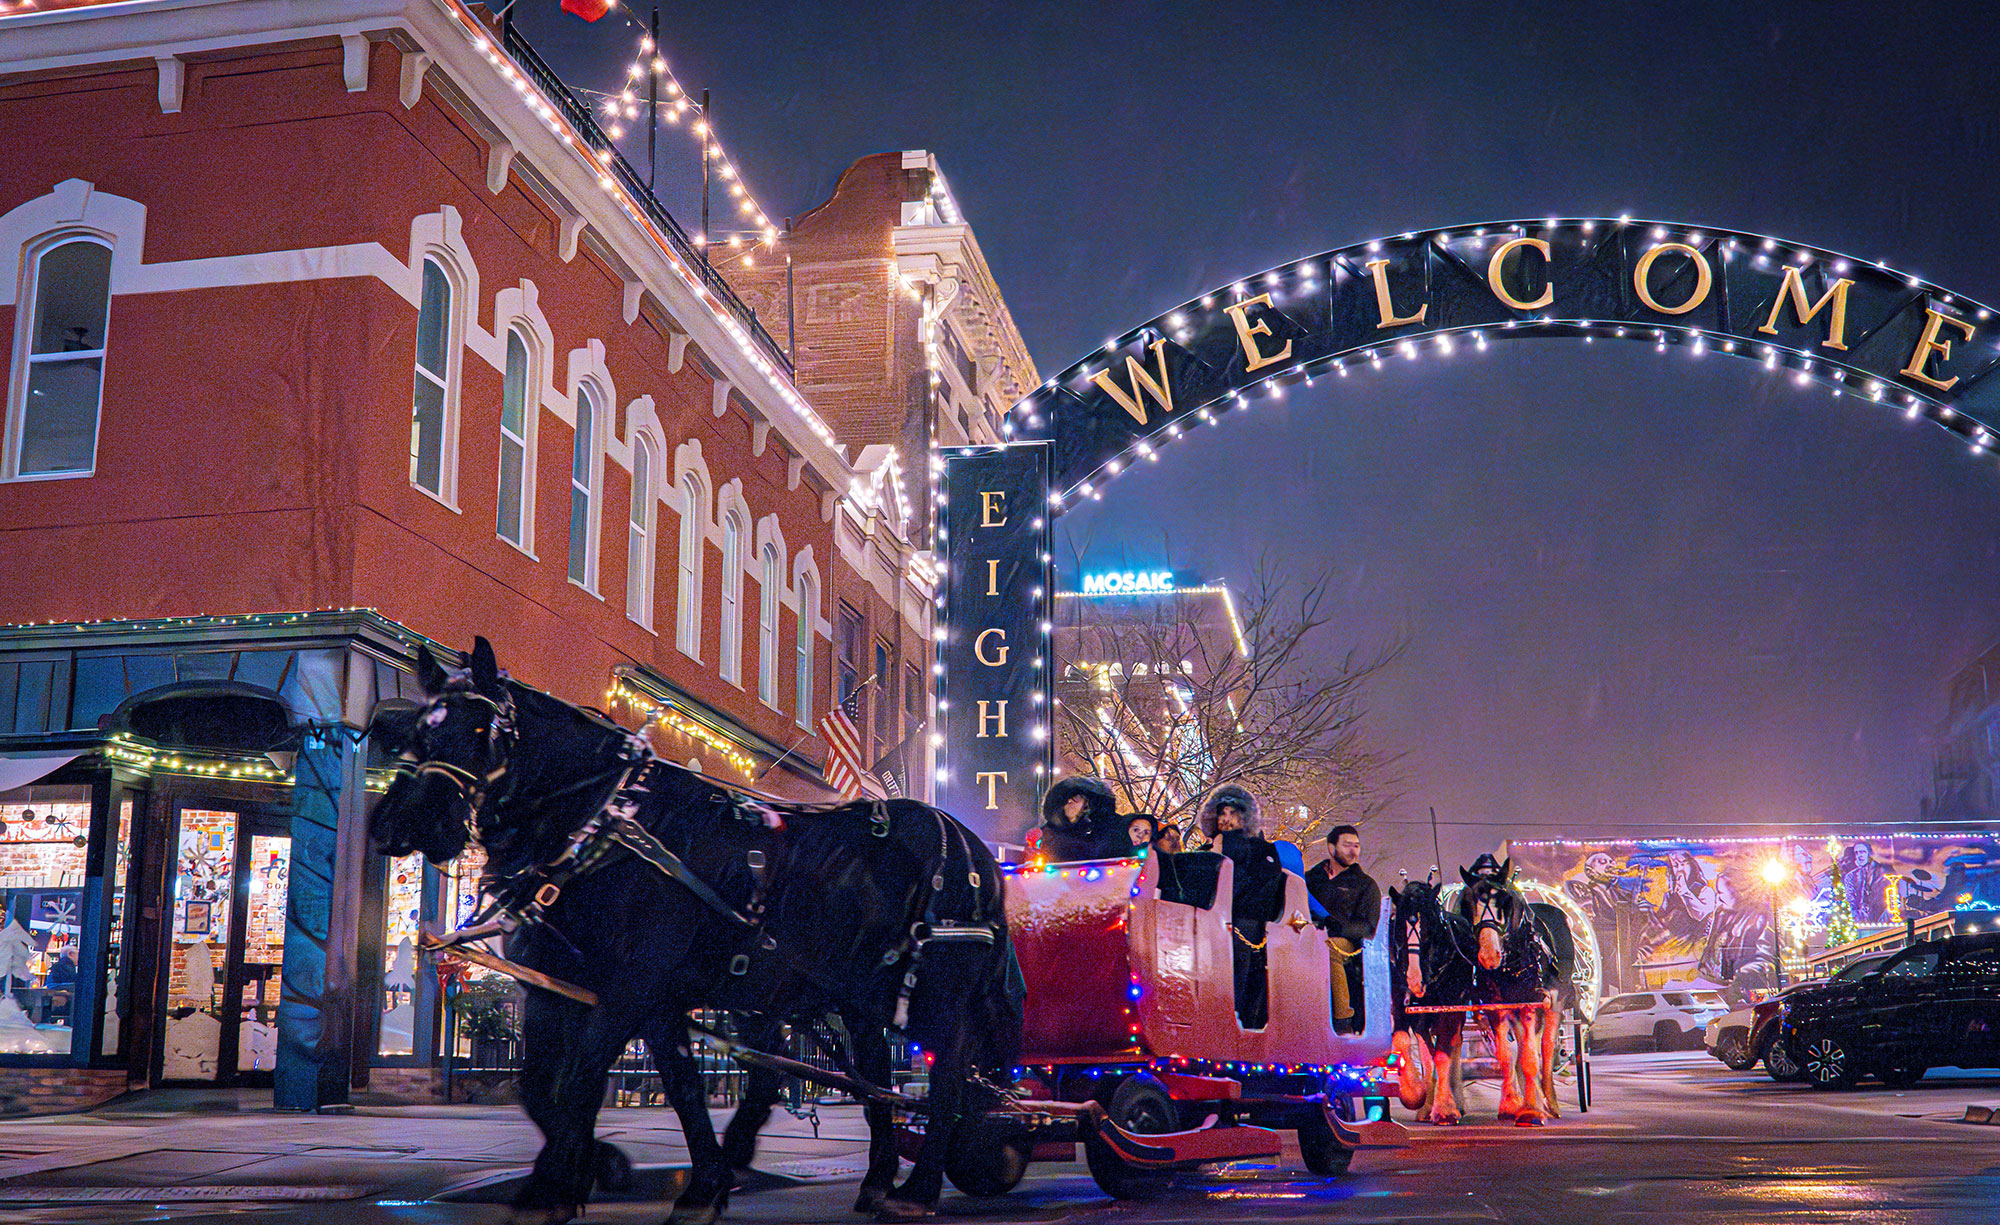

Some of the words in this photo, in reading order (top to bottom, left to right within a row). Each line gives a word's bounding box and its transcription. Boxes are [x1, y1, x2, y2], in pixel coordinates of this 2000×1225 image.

[1087, 236, 1977, 427] WELCOME
[974, 490, 1009, 810] EIGHT
[1083, 571, 1174, 592] MOSAIC
